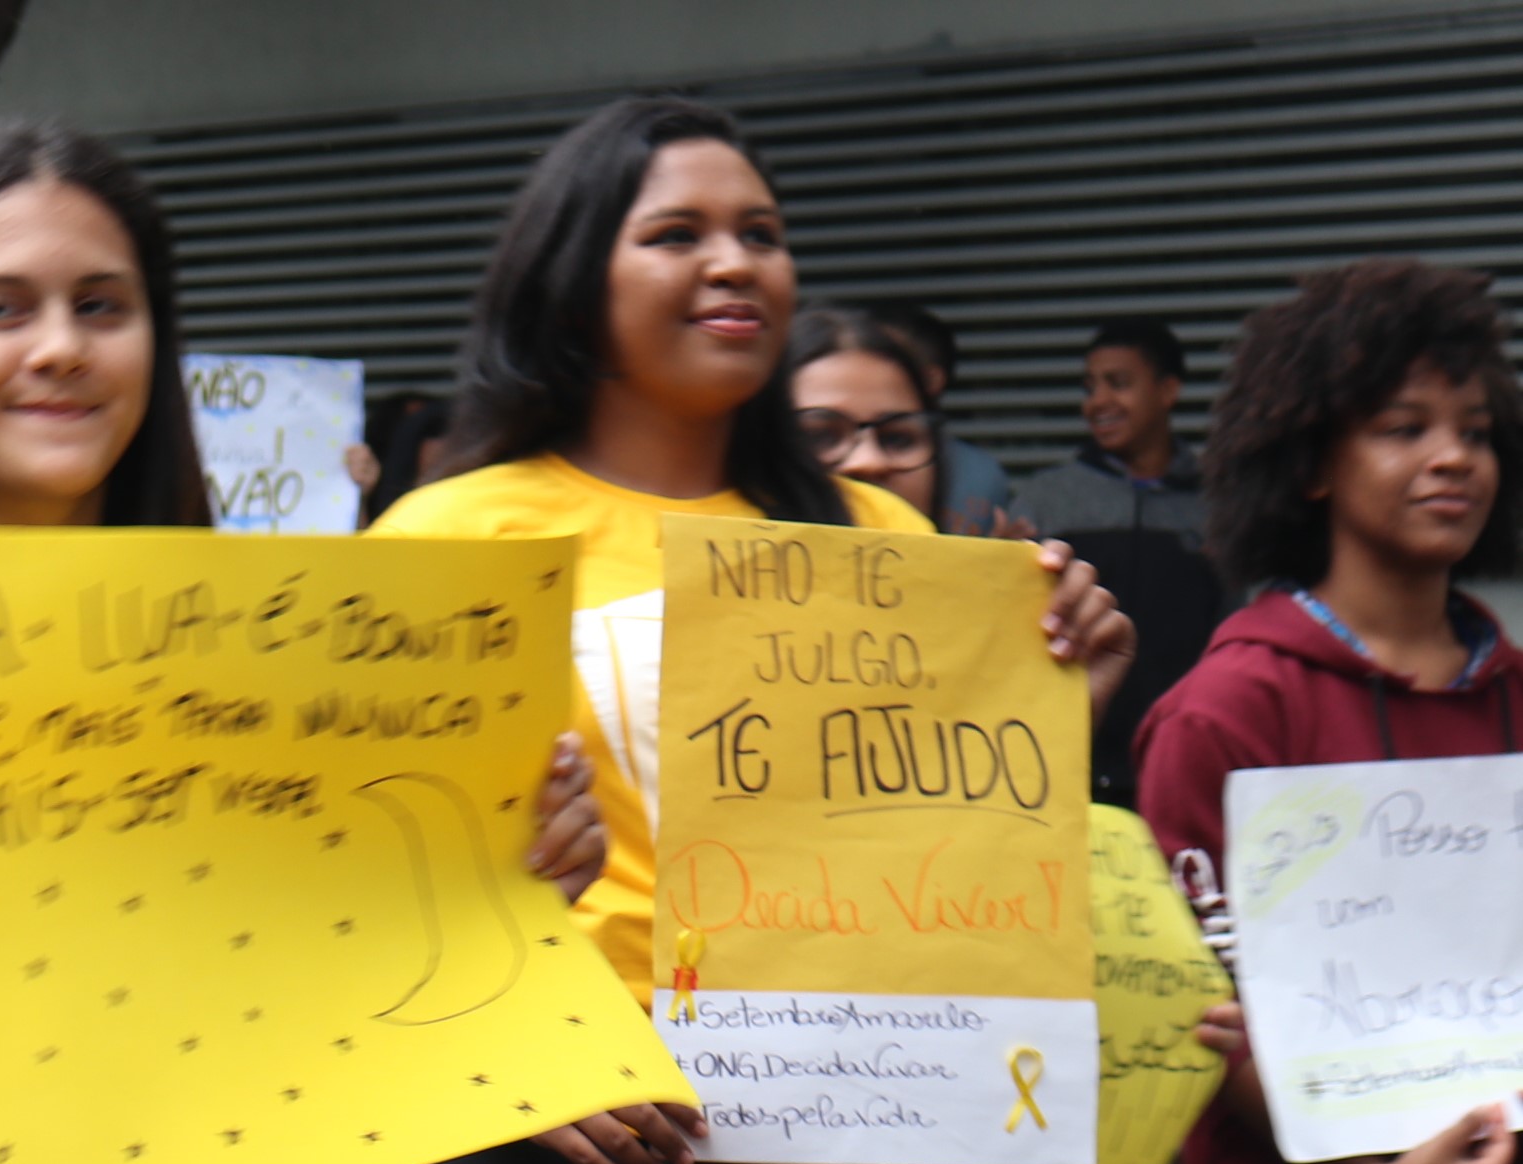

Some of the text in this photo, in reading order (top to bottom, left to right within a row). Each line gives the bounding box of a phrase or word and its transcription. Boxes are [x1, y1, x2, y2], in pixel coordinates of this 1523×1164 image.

[708, 524, 904, 610] NÃO TE
[753, 630, 938, 690] JULGO.
[688, 698, 1050, 810] TE AJUDO
[667, 839, 878, 936] Decida
